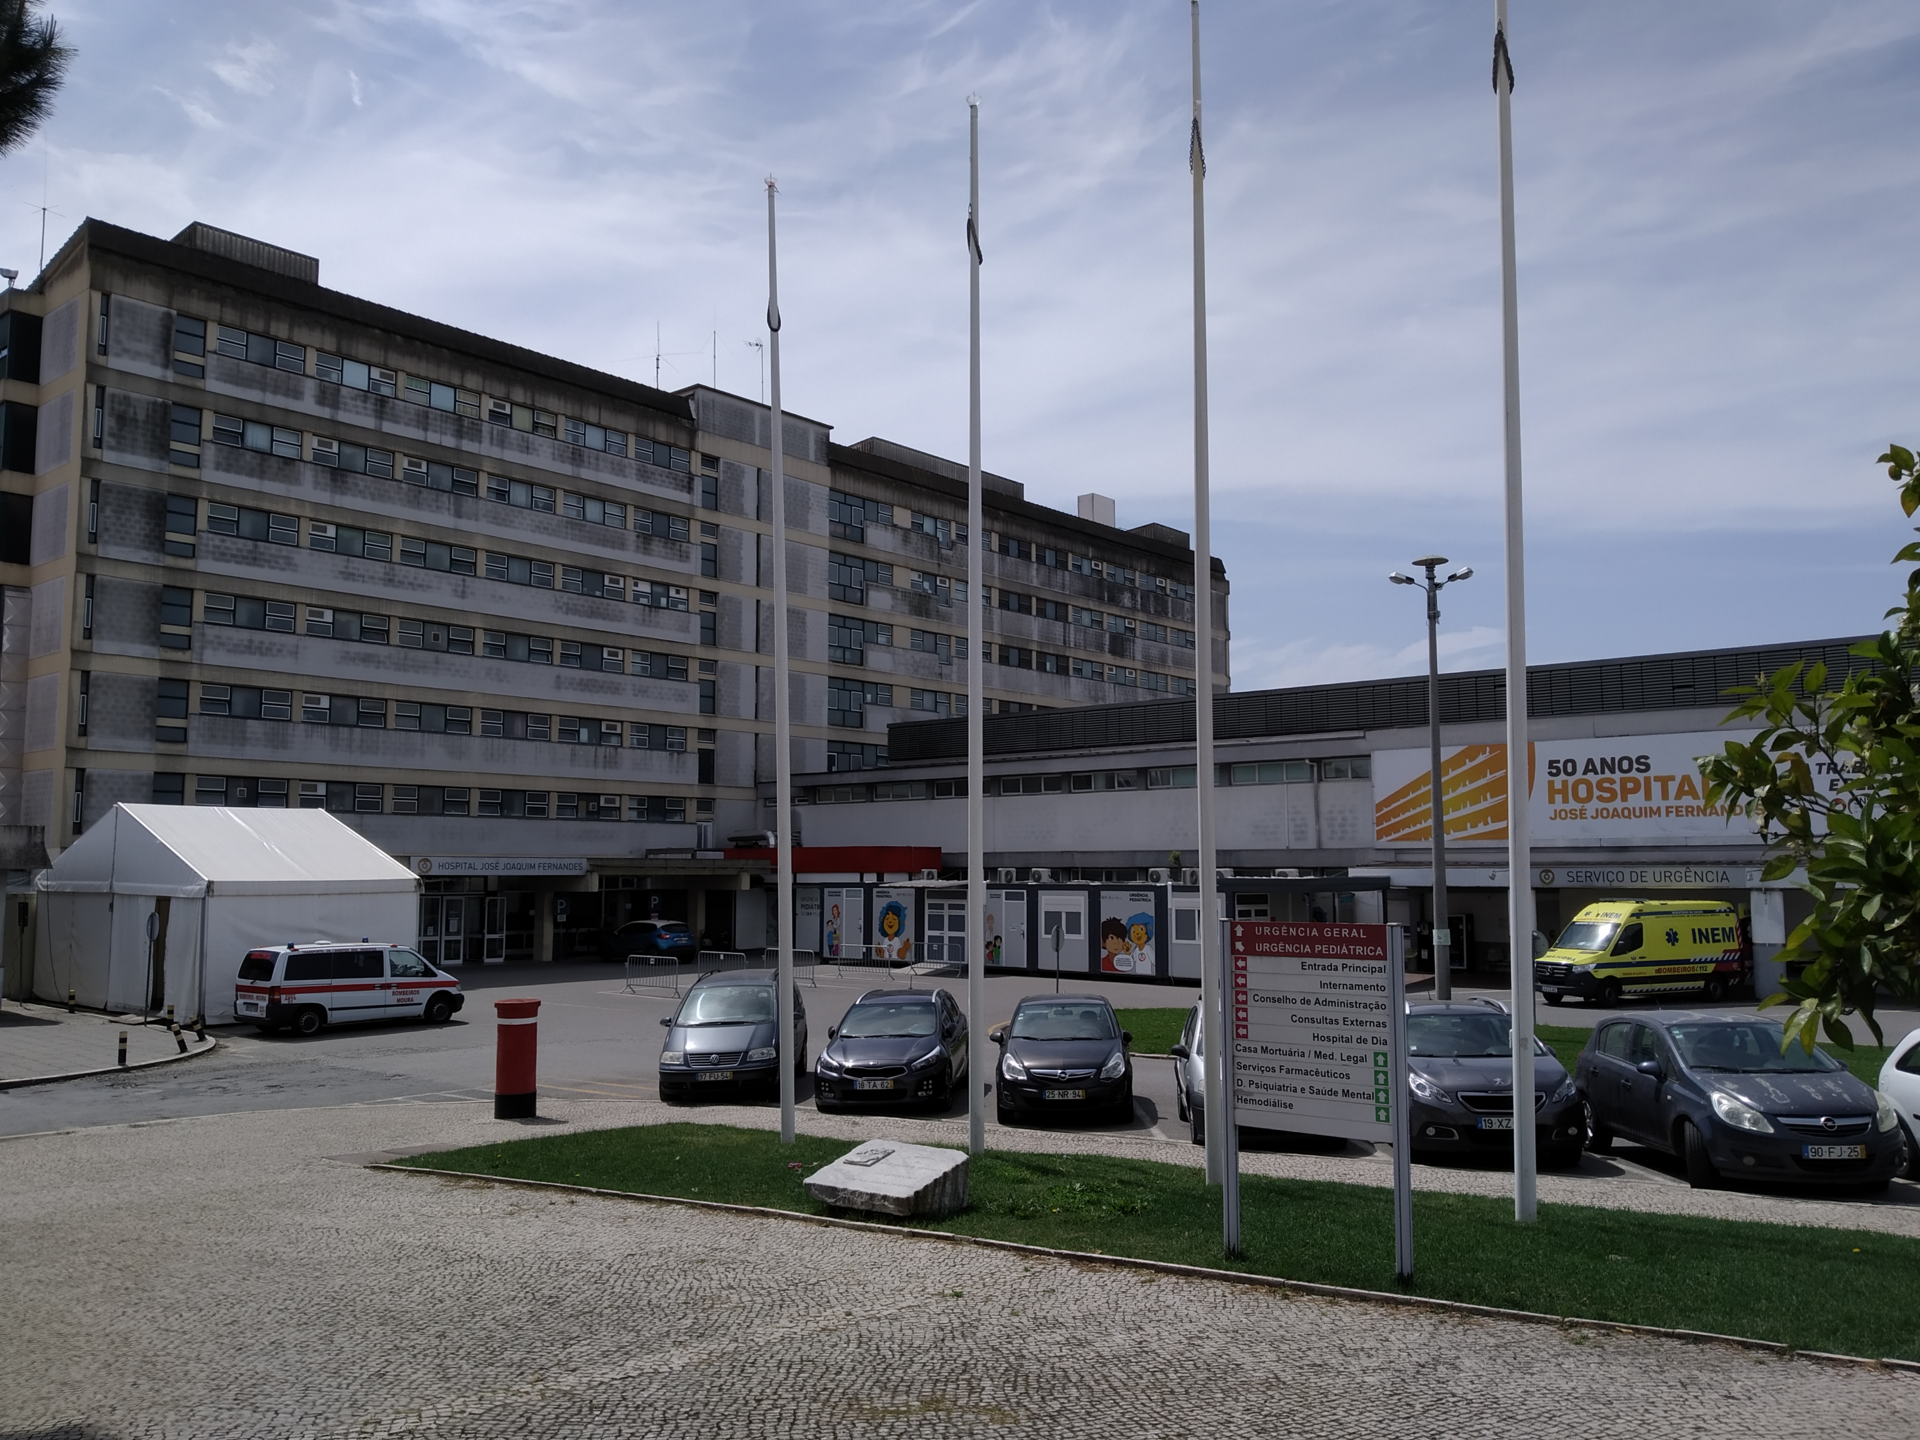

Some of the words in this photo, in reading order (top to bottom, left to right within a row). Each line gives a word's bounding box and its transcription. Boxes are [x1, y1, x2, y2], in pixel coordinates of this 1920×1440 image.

[1547, 758, 1577, 777] 50
[1582, 754, 1651, 776] ANOS
[1549, 805, 1587, 821] JOSÉ
[1590, 806, 1661, 820] JOAQUIM
[1665, 803, 1766, 818] FERNANDS
[438, 862, 478, 870] HOSPITAL
[480, 860, 500, 870] JOSÉ
[501, 863, 536, 871] JOAQUIM
[537, 863, 583, 871] FERNANDES
[1567, 870, 1625, 885] SERVIÇO
[1630, 870, 1648, 883] DE
[1653, 866, 1730, 883] URGÊNCIA
[1600, 911, 1622, 919] INEM
[1255, 925, 1319, 937] URGÊNCIA
[1324, 928, 1367, 938] GERAL
[1691, 927, 1736, 944] INEM
[1255, 942, 1312, 954] URGÊNCIA
[1315, 943, 1384, 956] PEDIÁTRICA
[1301, 961, 1338, 971] Entrada
[1341, 963, 1386, 975] Principal
[1320, 980, 1386, 992] Internamento
[1253, 993, 1297, 1005] Conselho
[1300, 996, 1311, 1005] de
[1314, 997, 1387, 1012] Administração
[1291, 1014, 1339, 1025] Consultas
[1343, 1017, 1387, 1028] Externas
[1312, 1033, 1353, 1045] Hospital
[1356, 1035, 1368, 1045] de
[1372, 1036, 1388, 1046] Dia
[1235, 1043, 1258, 1053] Casa
[1261, 1046, 1305, 1058] Mortuária
[1314, 1050, 1337, 1060] Med.
[1340, 1053, 1368, 1065] Legal
[1236, 1061, 1276, 1074] Serviços
[1279, 1065, 1351, 1080] Farmacêuticos
[1237, 1078, 1246, 1087] D.
[1248, 1080, 1298, 1094] Psiquiatria
[1309, 1085, 1339, 1097] Saúde
[1342, 1089, 1375, 1101] Mental
[1236, 1095, 1294, 1109] Hemodiálise
